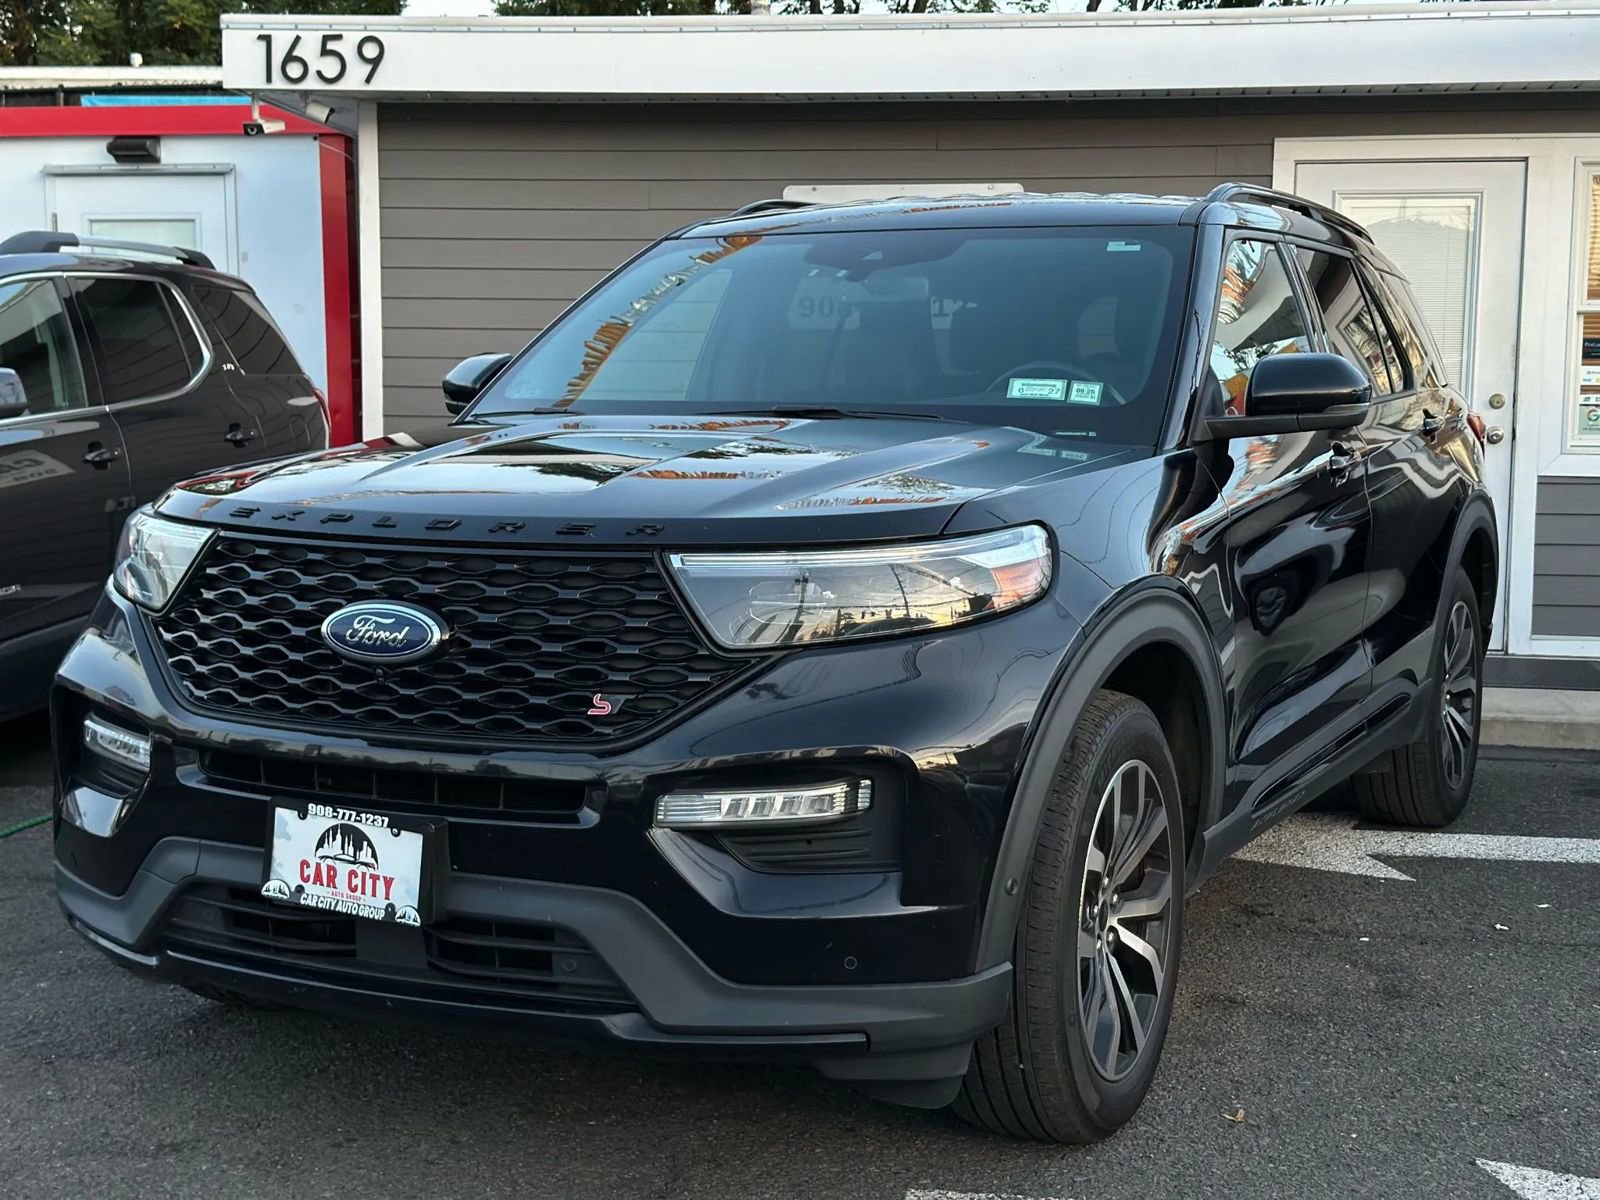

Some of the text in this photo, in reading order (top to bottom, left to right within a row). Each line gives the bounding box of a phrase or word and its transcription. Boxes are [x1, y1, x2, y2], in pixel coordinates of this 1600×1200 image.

[257, 34, 385, 84] 1659
[229, 506, 665, 537] EXPLORER
[345, 614, 411, 647] Ford
[308, 803, 389, 828] 908-777-1237
[299, 859, 396, 900] CAR CITY
[300, 893, 385, 920] CAR CITY AUTO GROUP
